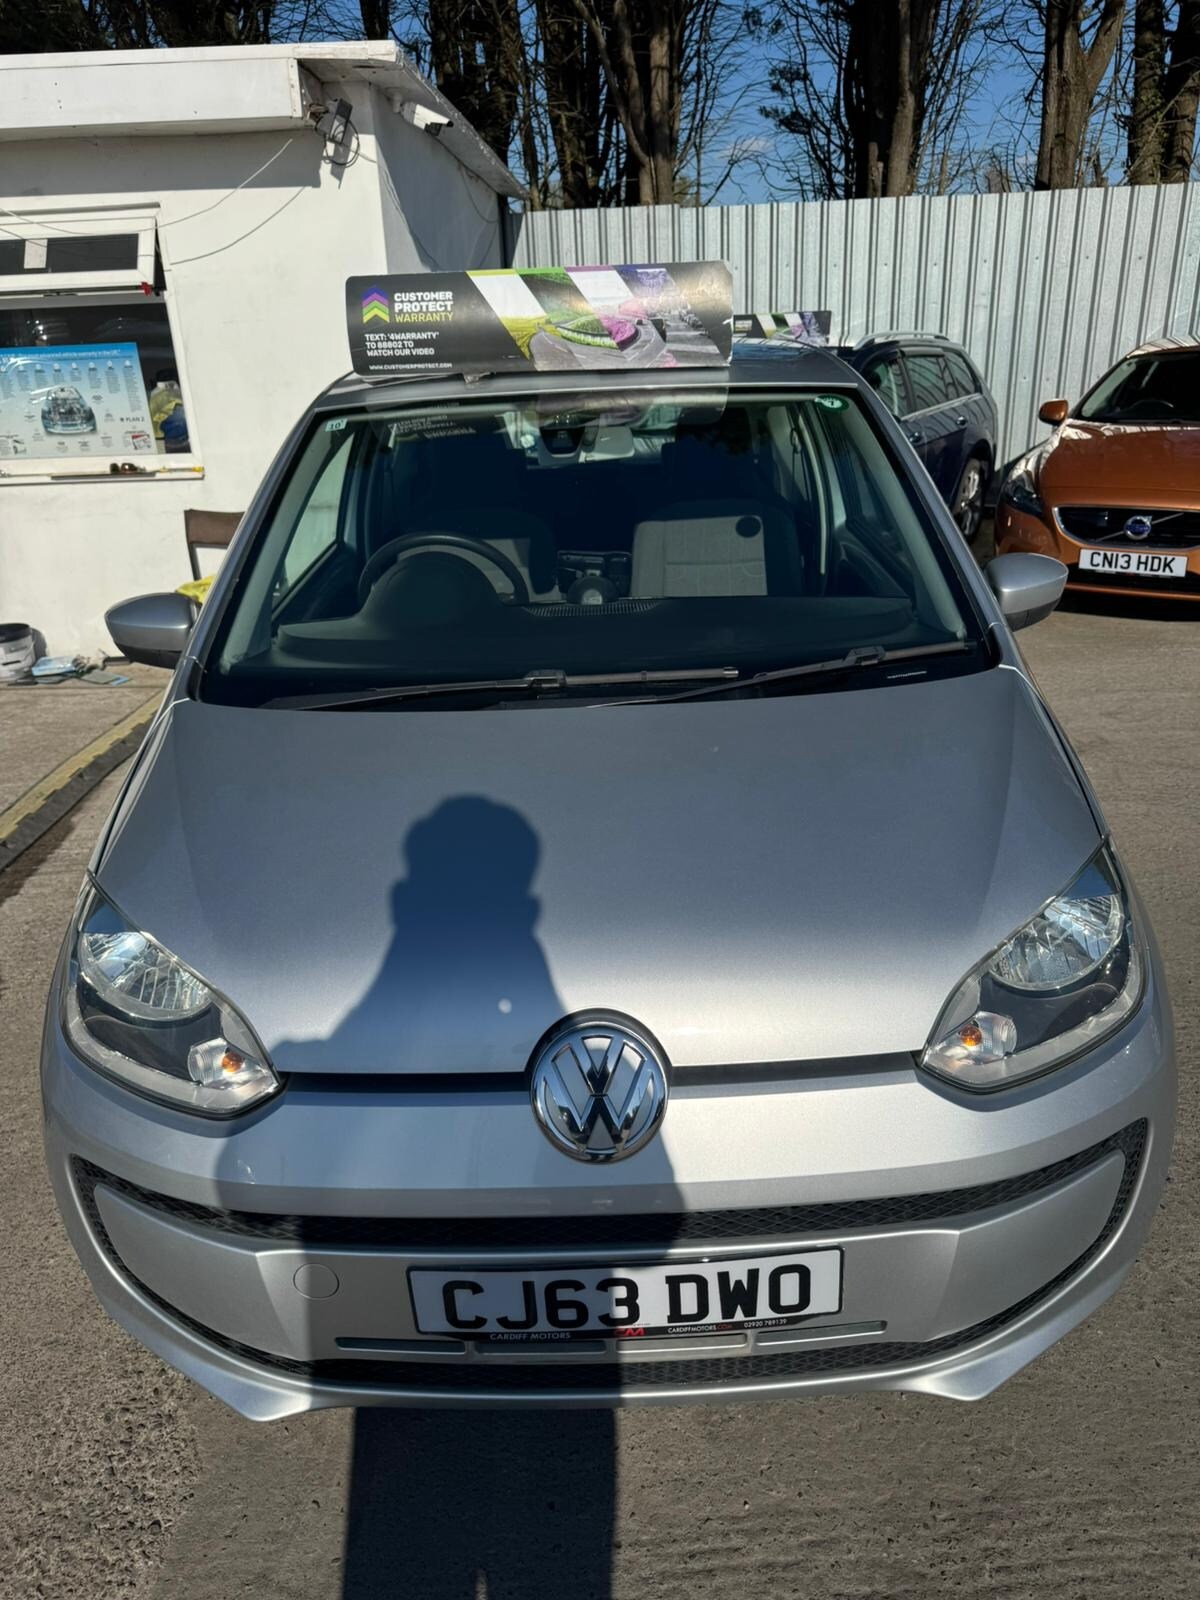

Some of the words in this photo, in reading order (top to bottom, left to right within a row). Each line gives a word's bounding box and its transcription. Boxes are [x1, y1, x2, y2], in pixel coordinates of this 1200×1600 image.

[394, 291, 453, 302] CUSTOMER
[394, 301, 454, 313] PROTECT
[395, 312, 454, 323] WARRANTY
[364, 333, 387, 342] TEXT:
[377, 341, 403, 349] 88802
[366, 349, 393, 357] WATCH
[394, 348, 411, 356] OUR
[411, 347, 435, 356] VIDEO
[368, 363, 453, 371] WWW.CUSTOMERPROTECT.COM
[1090, 551, 1132, 570] CN13
[1136, 555, 1176, 573] HDK
[441, 1279, 641, 1330] CJ63
[665, 1263, 812, 1323] DWO
[667, 1323, 733, 1334] CARDIFFMOTORS.COM
[489, 1332, 529, 1341] CARDIFF
[529, 1331, 572, 1340] MOTORS
